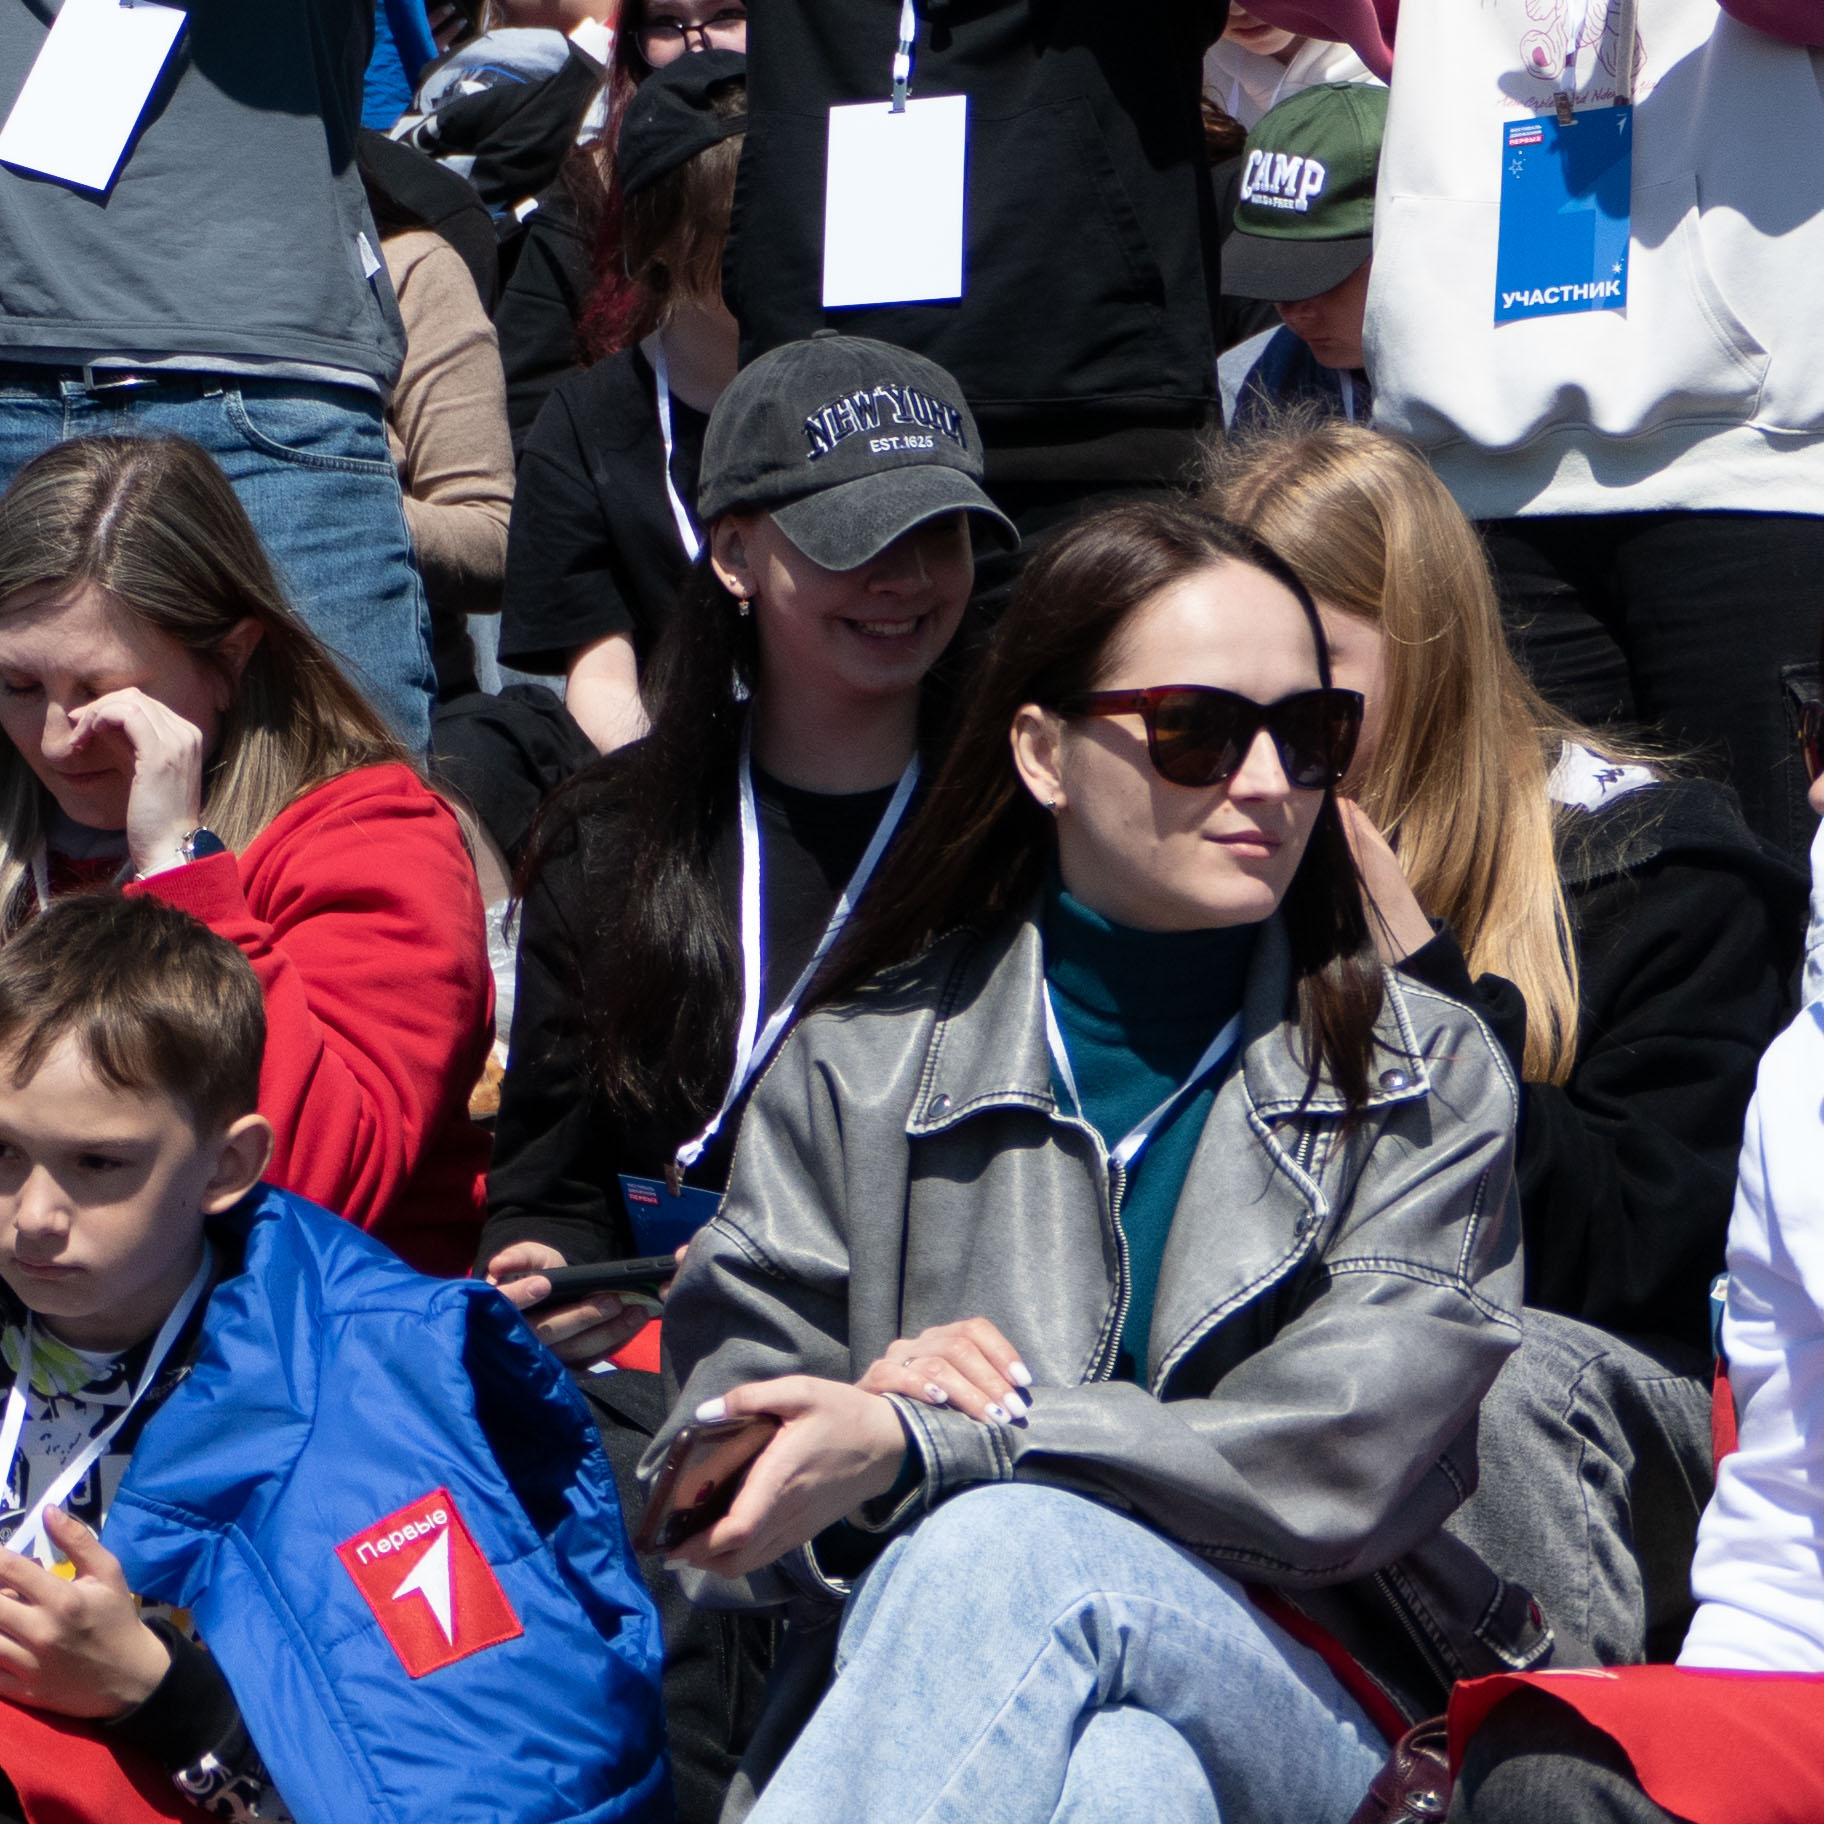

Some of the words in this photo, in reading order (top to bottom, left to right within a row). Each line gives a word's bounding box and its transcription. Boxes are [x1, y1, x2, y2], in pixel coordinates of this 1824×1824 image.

[1240, 149, 1326, 212] CAMP
[1502, 279, 1621, 309] УЧАСТНИК
[802, 388, 881, 461] NEW
[875, 383, 969, 452] YORK
[356, 1509, 448, 1565] Первые
